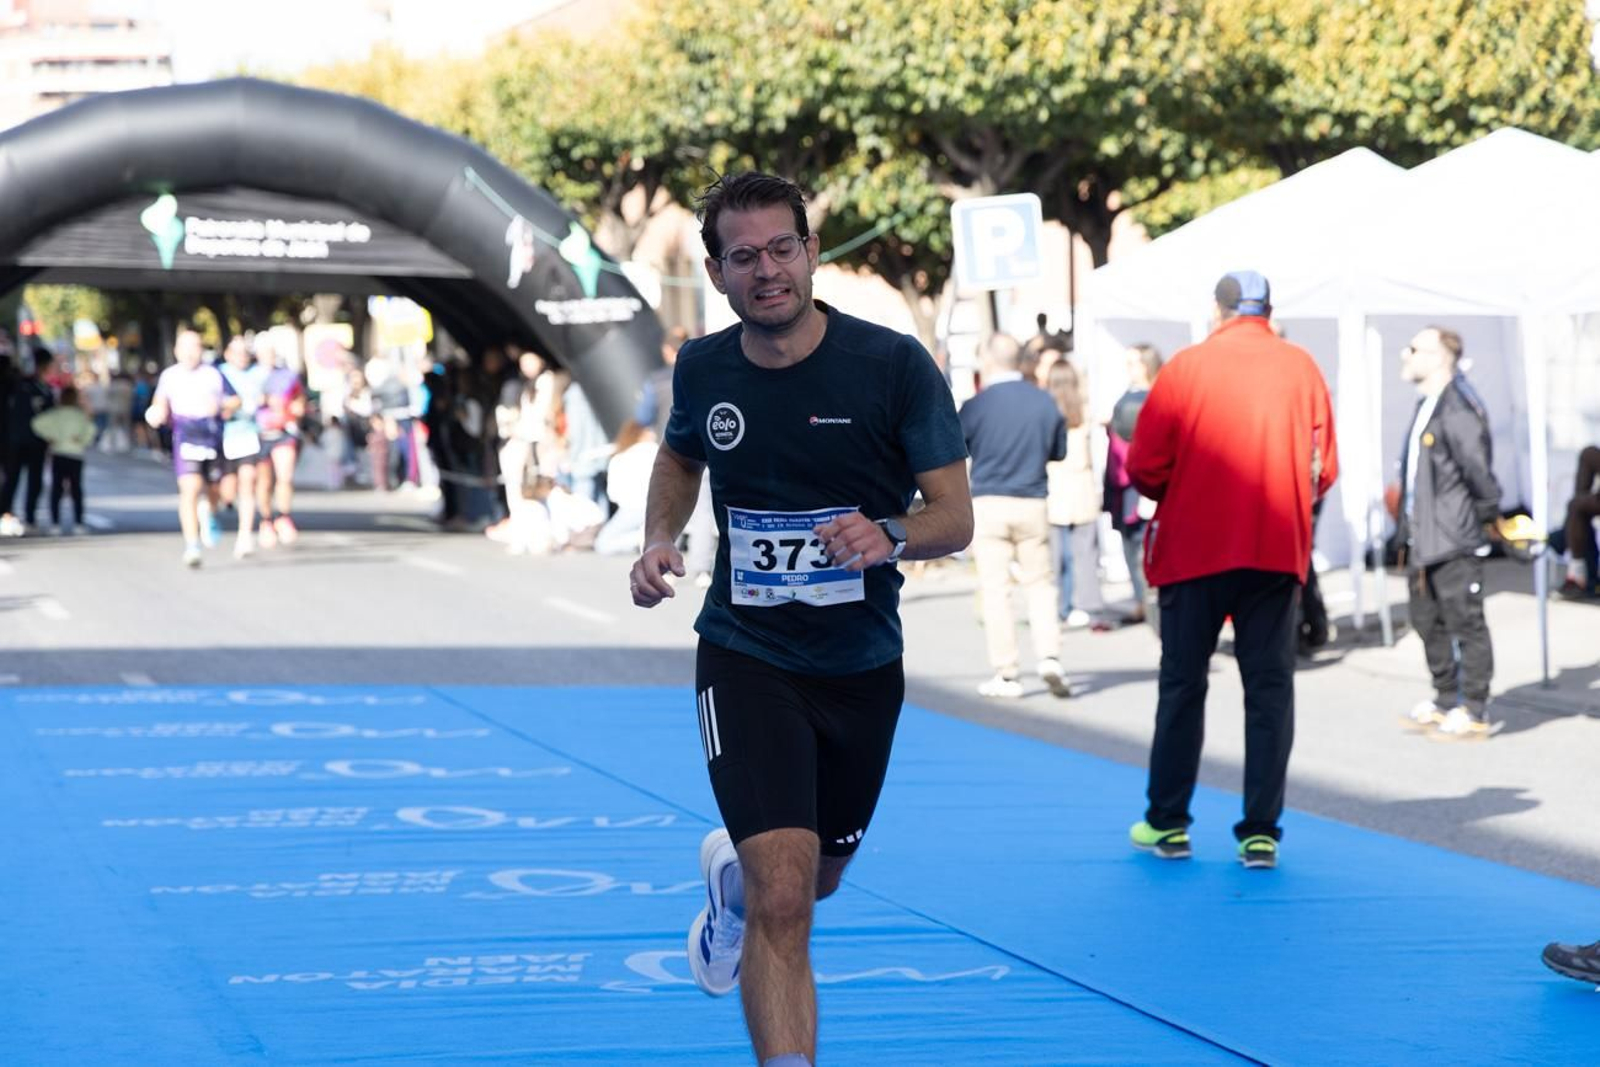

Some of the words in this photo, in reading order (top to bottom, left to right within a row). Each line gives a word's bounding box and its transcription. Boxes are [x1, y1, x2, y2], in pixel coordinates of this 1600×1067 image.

[971, 208, 1026, 279] P
[751, 538, 833, 571] 373
[781, 574, 809, 582] PEDRO
[345, 975, 580, 990] MEDIA
